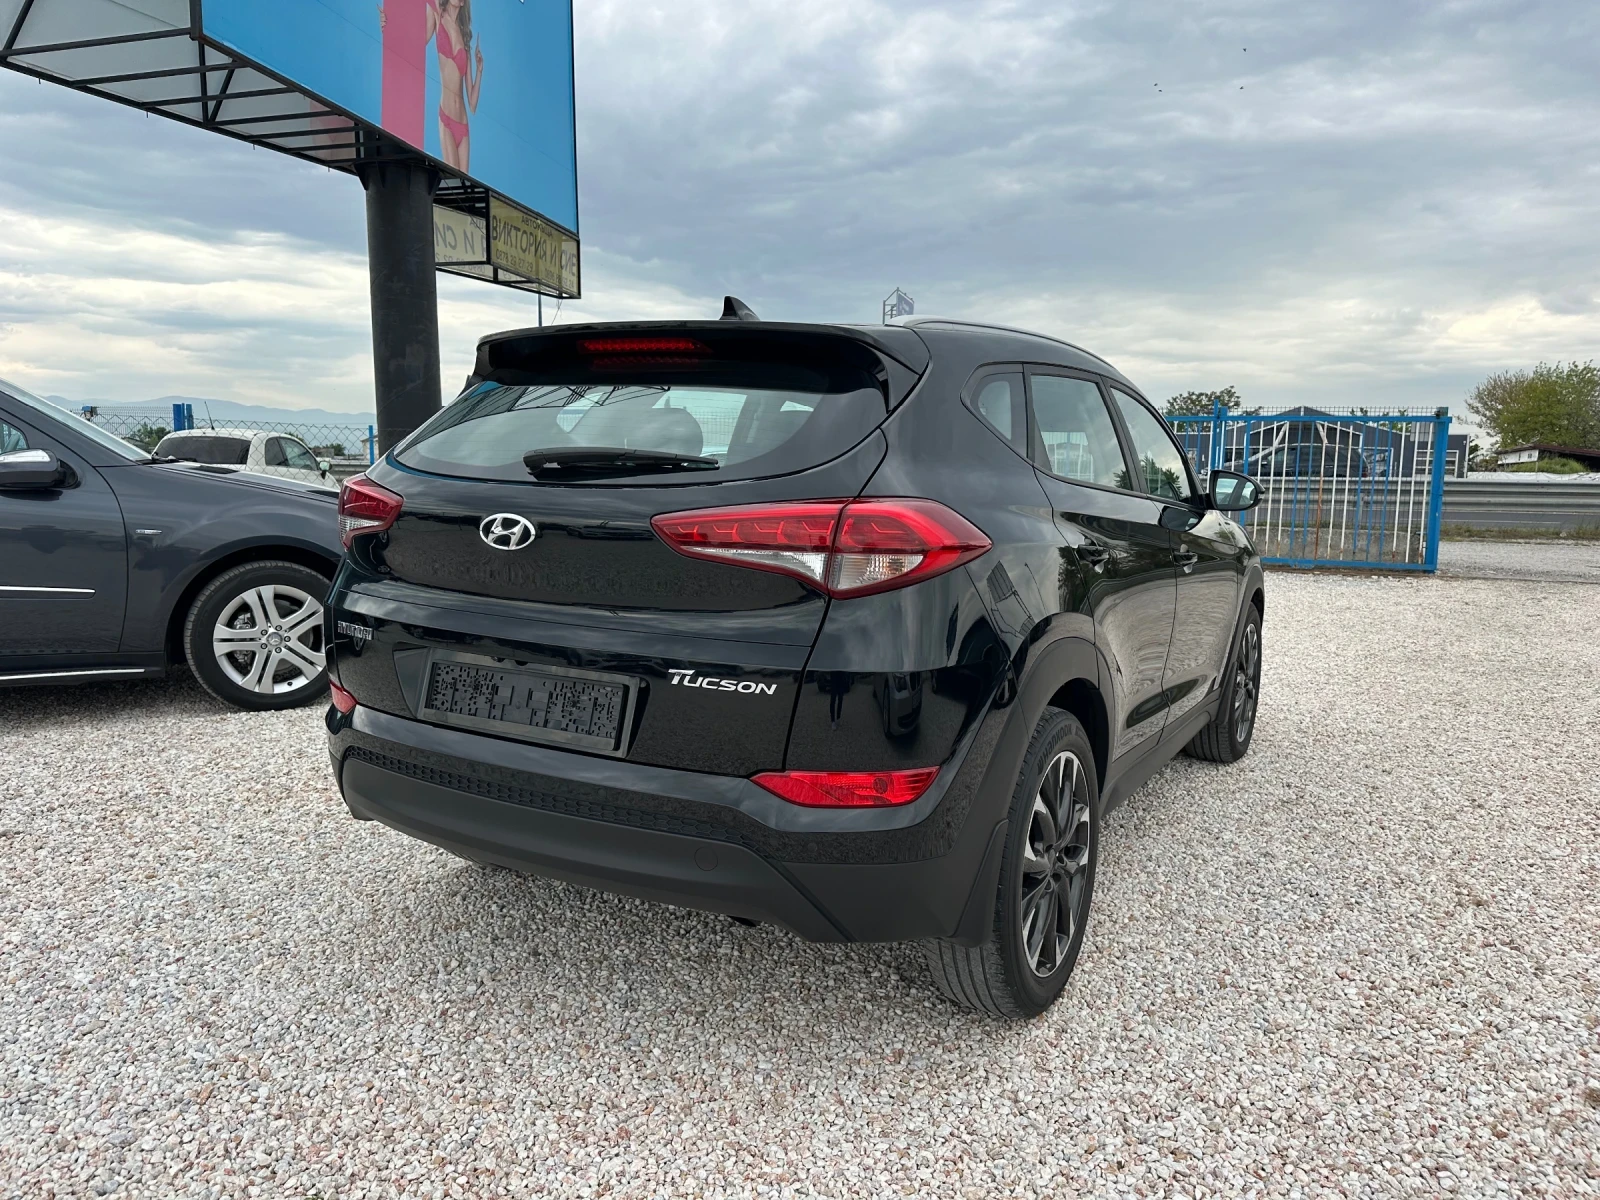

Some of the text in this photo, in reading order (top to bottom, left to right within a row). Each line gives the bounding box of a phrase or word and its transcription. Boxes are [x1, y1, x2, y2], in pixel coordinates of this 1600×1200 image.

[491, 214, 547, 263] ВИКТОРИЯ
[550, 242, 557, 267] И
[560, 249, 577, 276] СИЕ
[337, 620, 372, 640] HYUNDAI
